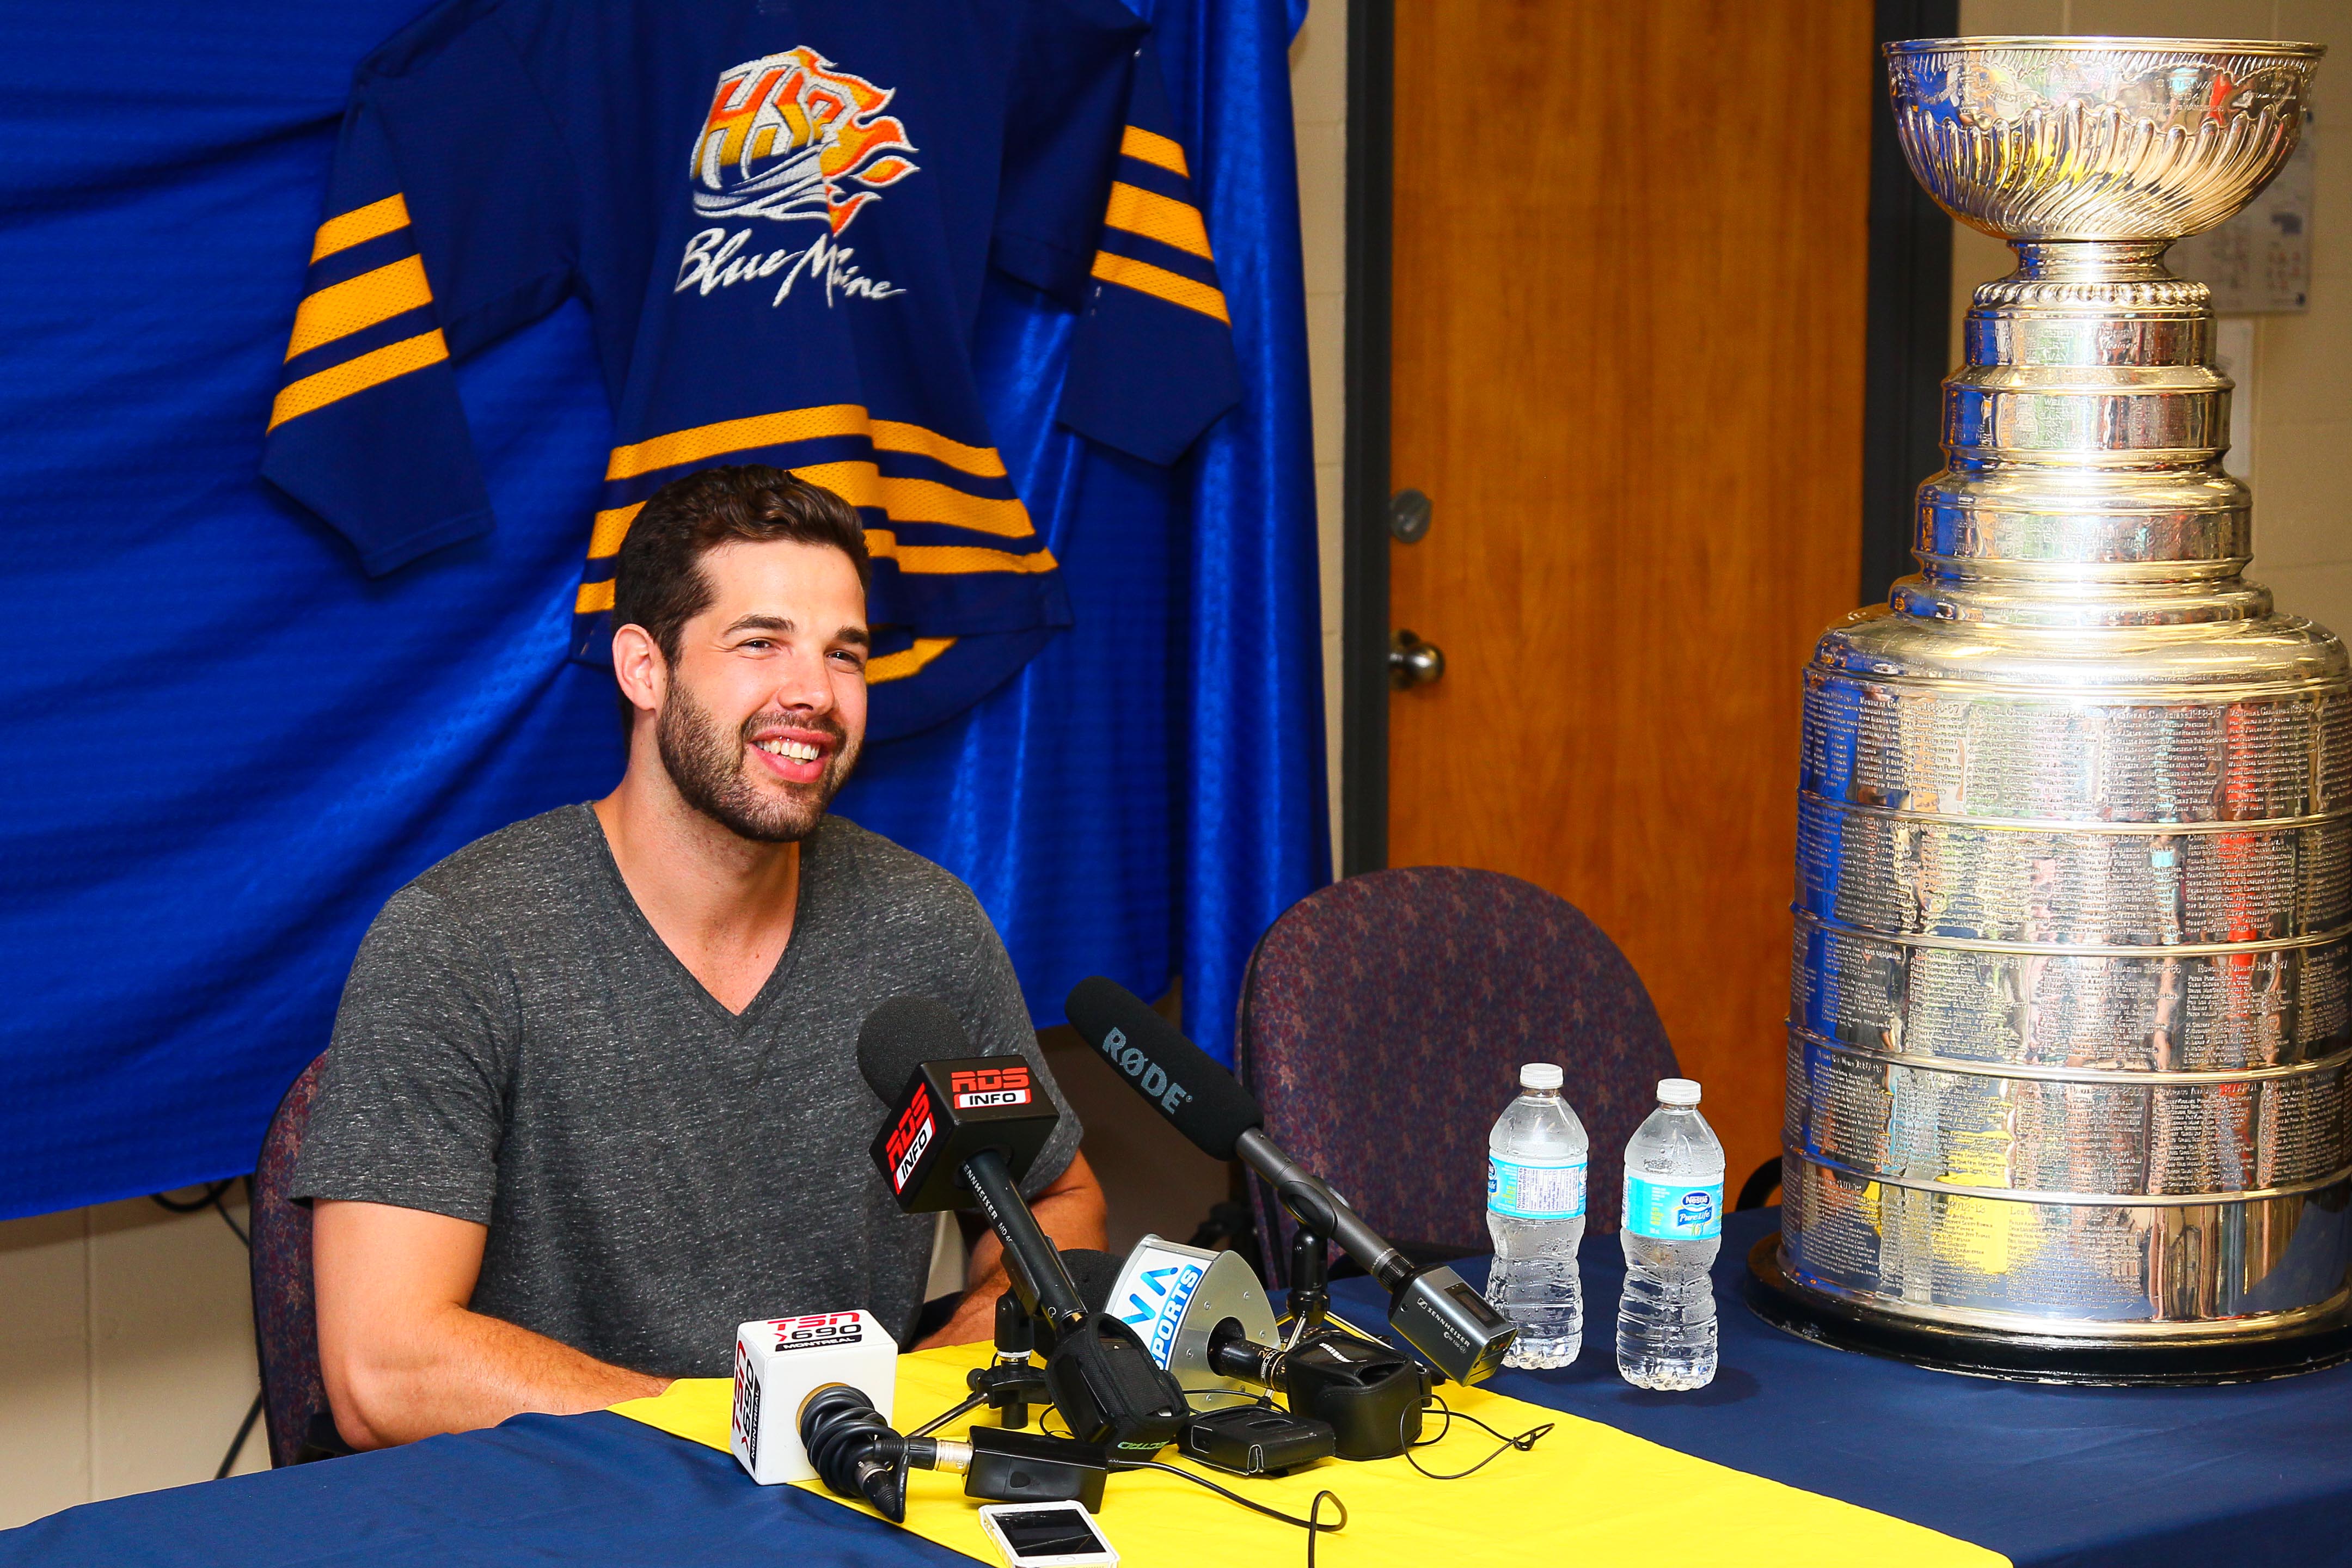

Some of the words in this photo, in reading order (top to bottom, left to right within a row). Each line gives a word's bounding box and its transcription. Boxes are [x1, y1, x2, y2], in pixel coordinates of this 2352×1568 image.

[674, 228, 806, 295] Blue
[951, 1067, 1029, 1092] RDS
[969, 1092, 1016, 1105] INFO
[886, 1082, 930, 1172] RDS
[901, 1129, 927, 1179] INFO
[1686, 1196, 1708, 1204] Nestlé
[1680, 1213, 1699, 1222] Pure
[1698, 1210, 1710, 1220] Life
[767, 1312, 860, 1331] TSN
[791, 1324, 861, 1340] 690
[1427, 1307, 1471, 1347] SENNHEISER
[783, 1337, 856, 1349] MONTREAL
[743, 1358, 754, 1437] 690
[751, 1389, 759, 1459] MONTREAL
